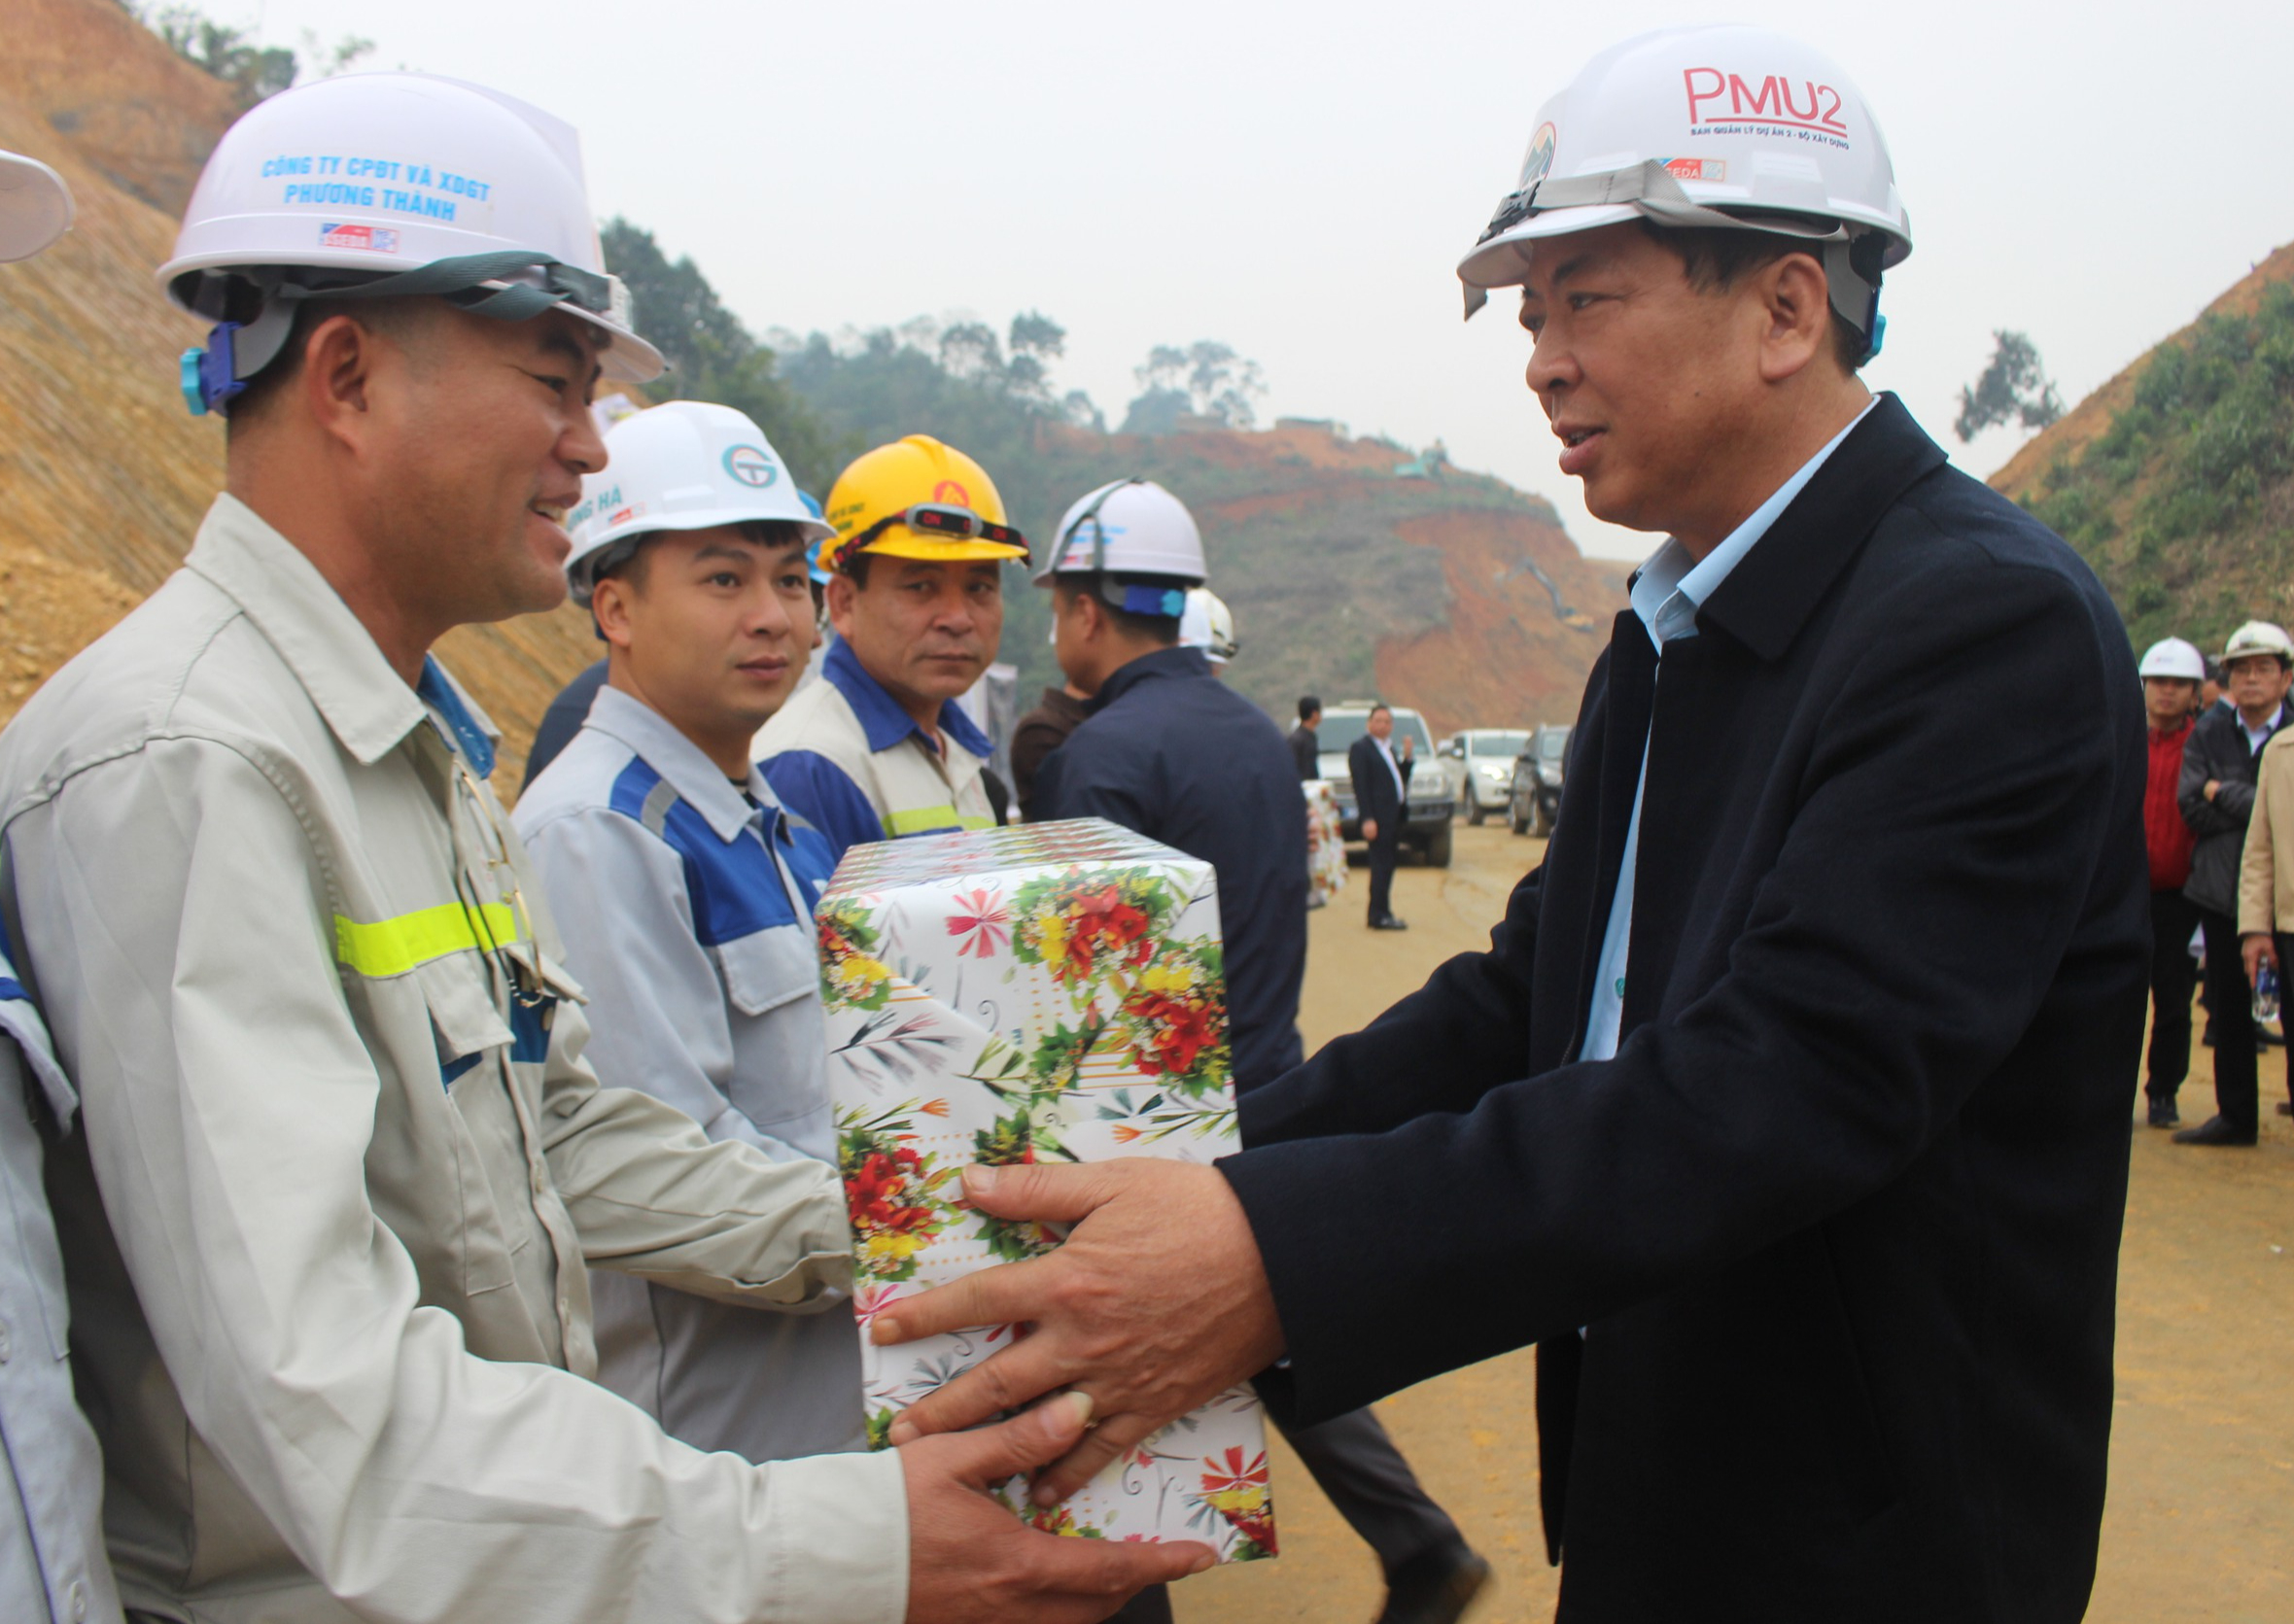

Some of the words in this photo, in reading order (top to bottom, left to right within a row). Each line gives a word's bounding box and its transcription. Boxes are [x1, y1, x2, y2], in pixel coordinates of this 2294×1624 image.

[1684, 67, 1846, 129] PMU2
[261, 155, 311, 177] CÔNG
[319, 156, 341, 174] TY
[439, 172, 489, 201] XDGT
[284, 183, 374, 206] PHƯƠNG
[383, 190, 455, 222] THÀNH
